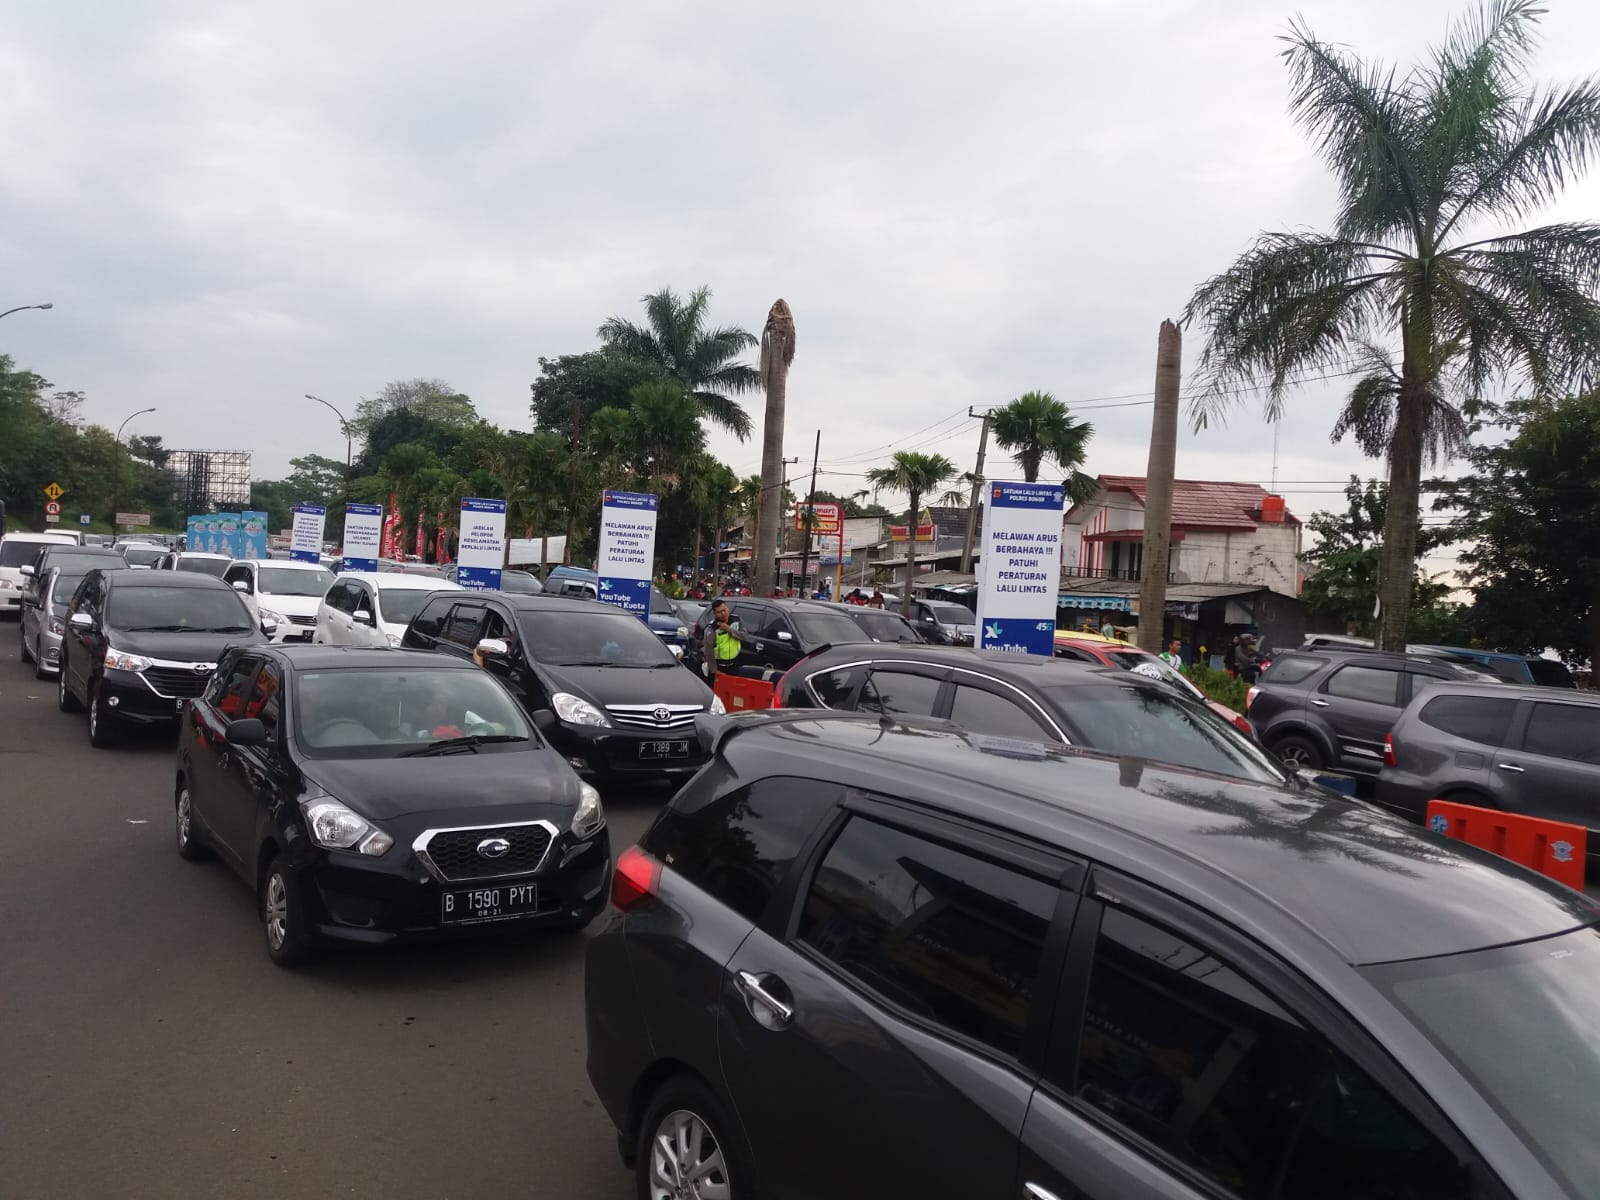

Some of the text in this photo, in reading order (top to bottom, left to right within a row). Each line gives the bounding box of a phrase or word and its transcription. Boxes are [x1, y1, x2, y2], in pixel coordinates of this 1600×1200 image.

[605, 522, 635, 530] MELAWAN
[607, 531, 643, 539] BERBAHAYA
[992, 532, 1058, 543] MELAWAN ARUS
[609, 547, 645, 555] PERATURAN
[996, 545, 1053, 555] BERBAHAYA !!!
[1009, 559, 1039, 567] PATUHI
[998, 571, 1047, 581] PERATURAN
[996, 584, 1047, 594] LALU LINTAS
[600, 593, 631, 602] YouTube
[623, 602, 646, 610] Kuota
[445, 886, 534, 912] B 1590 PYT
